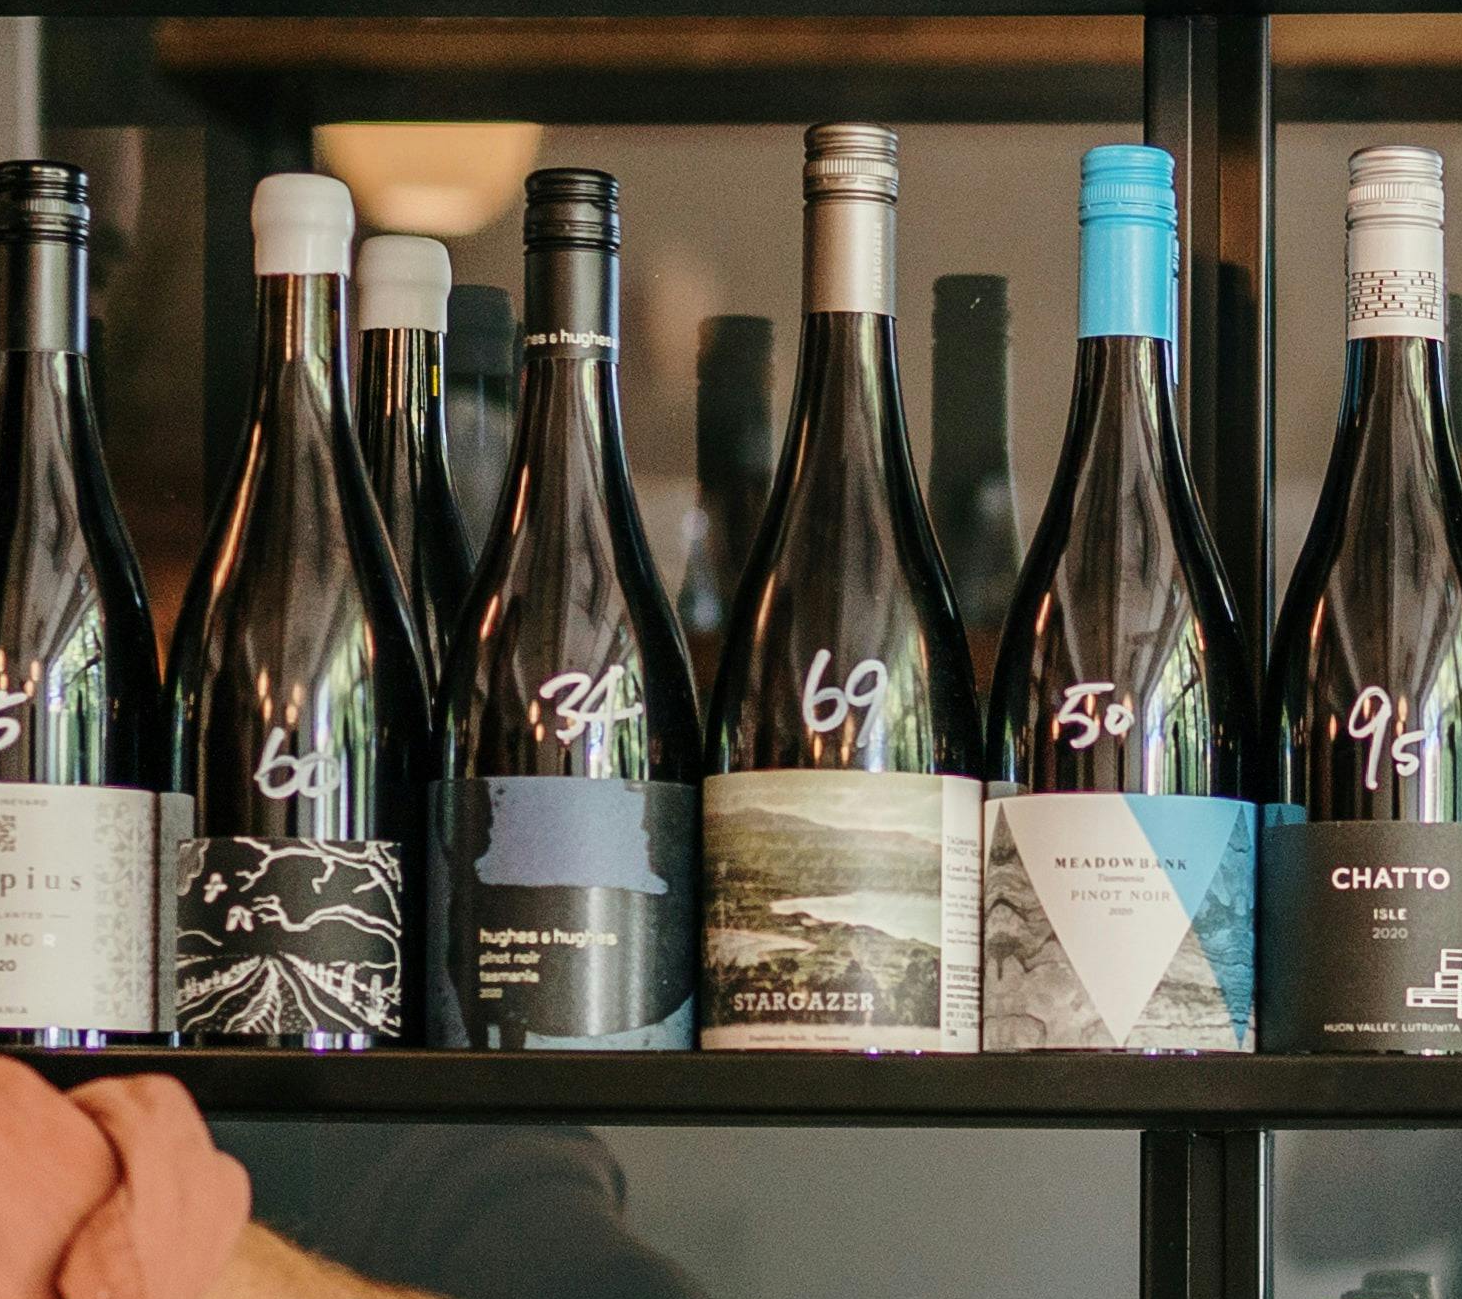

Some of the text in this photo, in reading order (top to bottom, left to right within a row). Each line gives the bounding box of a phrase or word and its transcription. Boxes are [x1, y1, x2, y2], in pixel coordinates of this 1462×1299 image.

[802, 648, 888, 749] 69
[539, 664, 644, 780] 34
[1057, 682, 1136, 750] 50
[1348, 686, 1427, 791] 95
[254, 726, 341, 799] 60
[1054, 857, 1188, 870] MEADOWBANK
[1331, 867, 1451, 890] CHATTO
[1071, 889, 1171, 901] PINOT NOIR
[1373, 908, 1407, 921] ISLE
[1372, 927, 1408, 940] 2020
[733, 992, 875, 1013] STARGAZER
